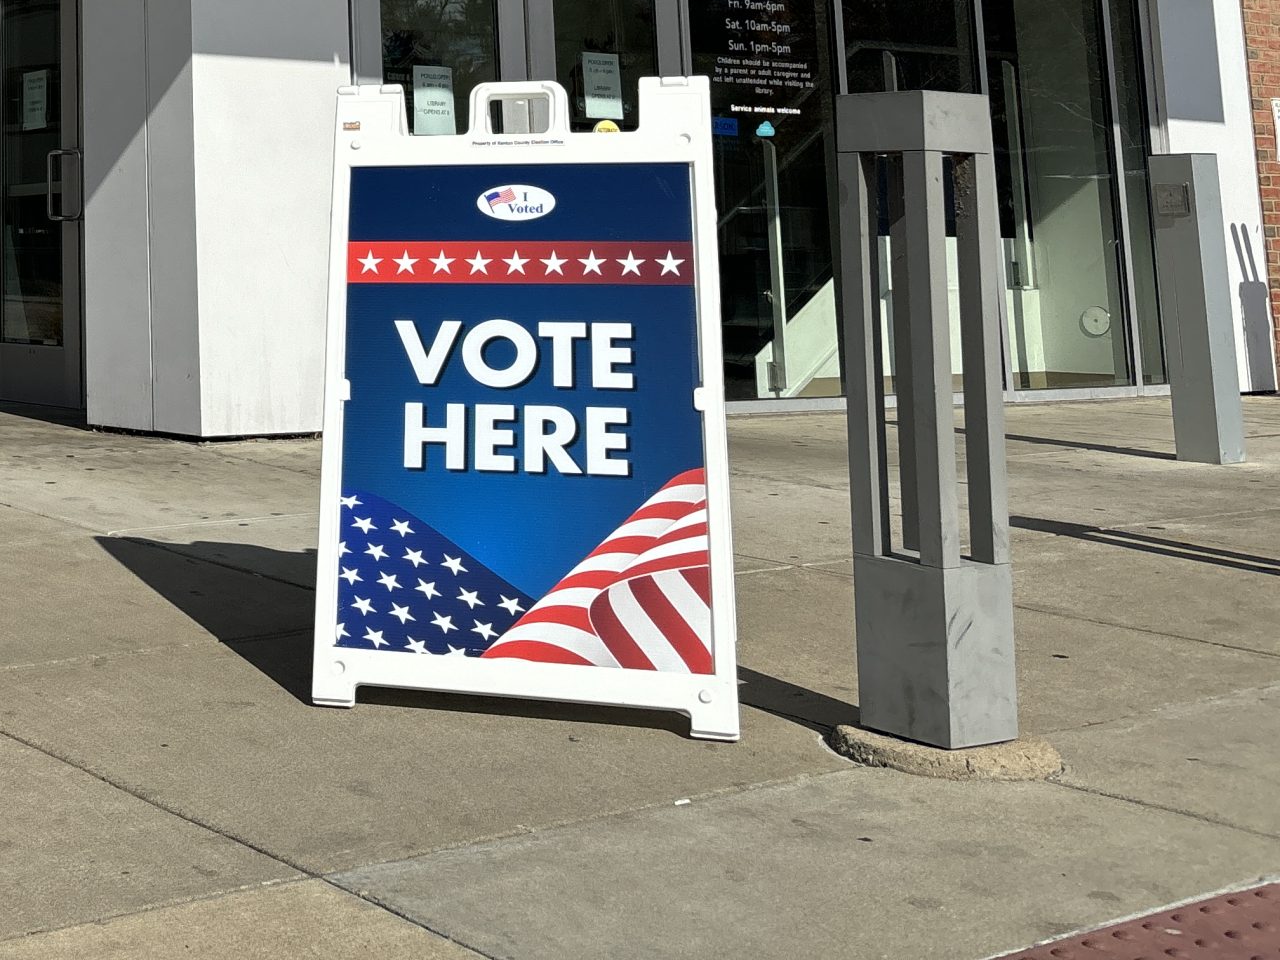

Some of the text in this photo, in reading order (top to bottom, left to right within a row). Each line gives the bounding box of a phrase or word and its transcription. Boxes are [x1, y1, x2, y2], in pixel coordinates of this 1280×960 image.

[725, 18, 791, 35] Sat. 10am-5pm
[728, 39, 792, 55] Sun. 1pm-5pm
[717, 57, 740, 65] Children
[771, 61, 808, 69] accompanied
[730, 104, 752, 112] Service
[753, 105, 775, 114] animals
[522, 191, 529, 202] I
[508, 203, 544, 214] Voted
[394, 318, 635, 389] VOTE
[404, 402, 631, 476] HERE
